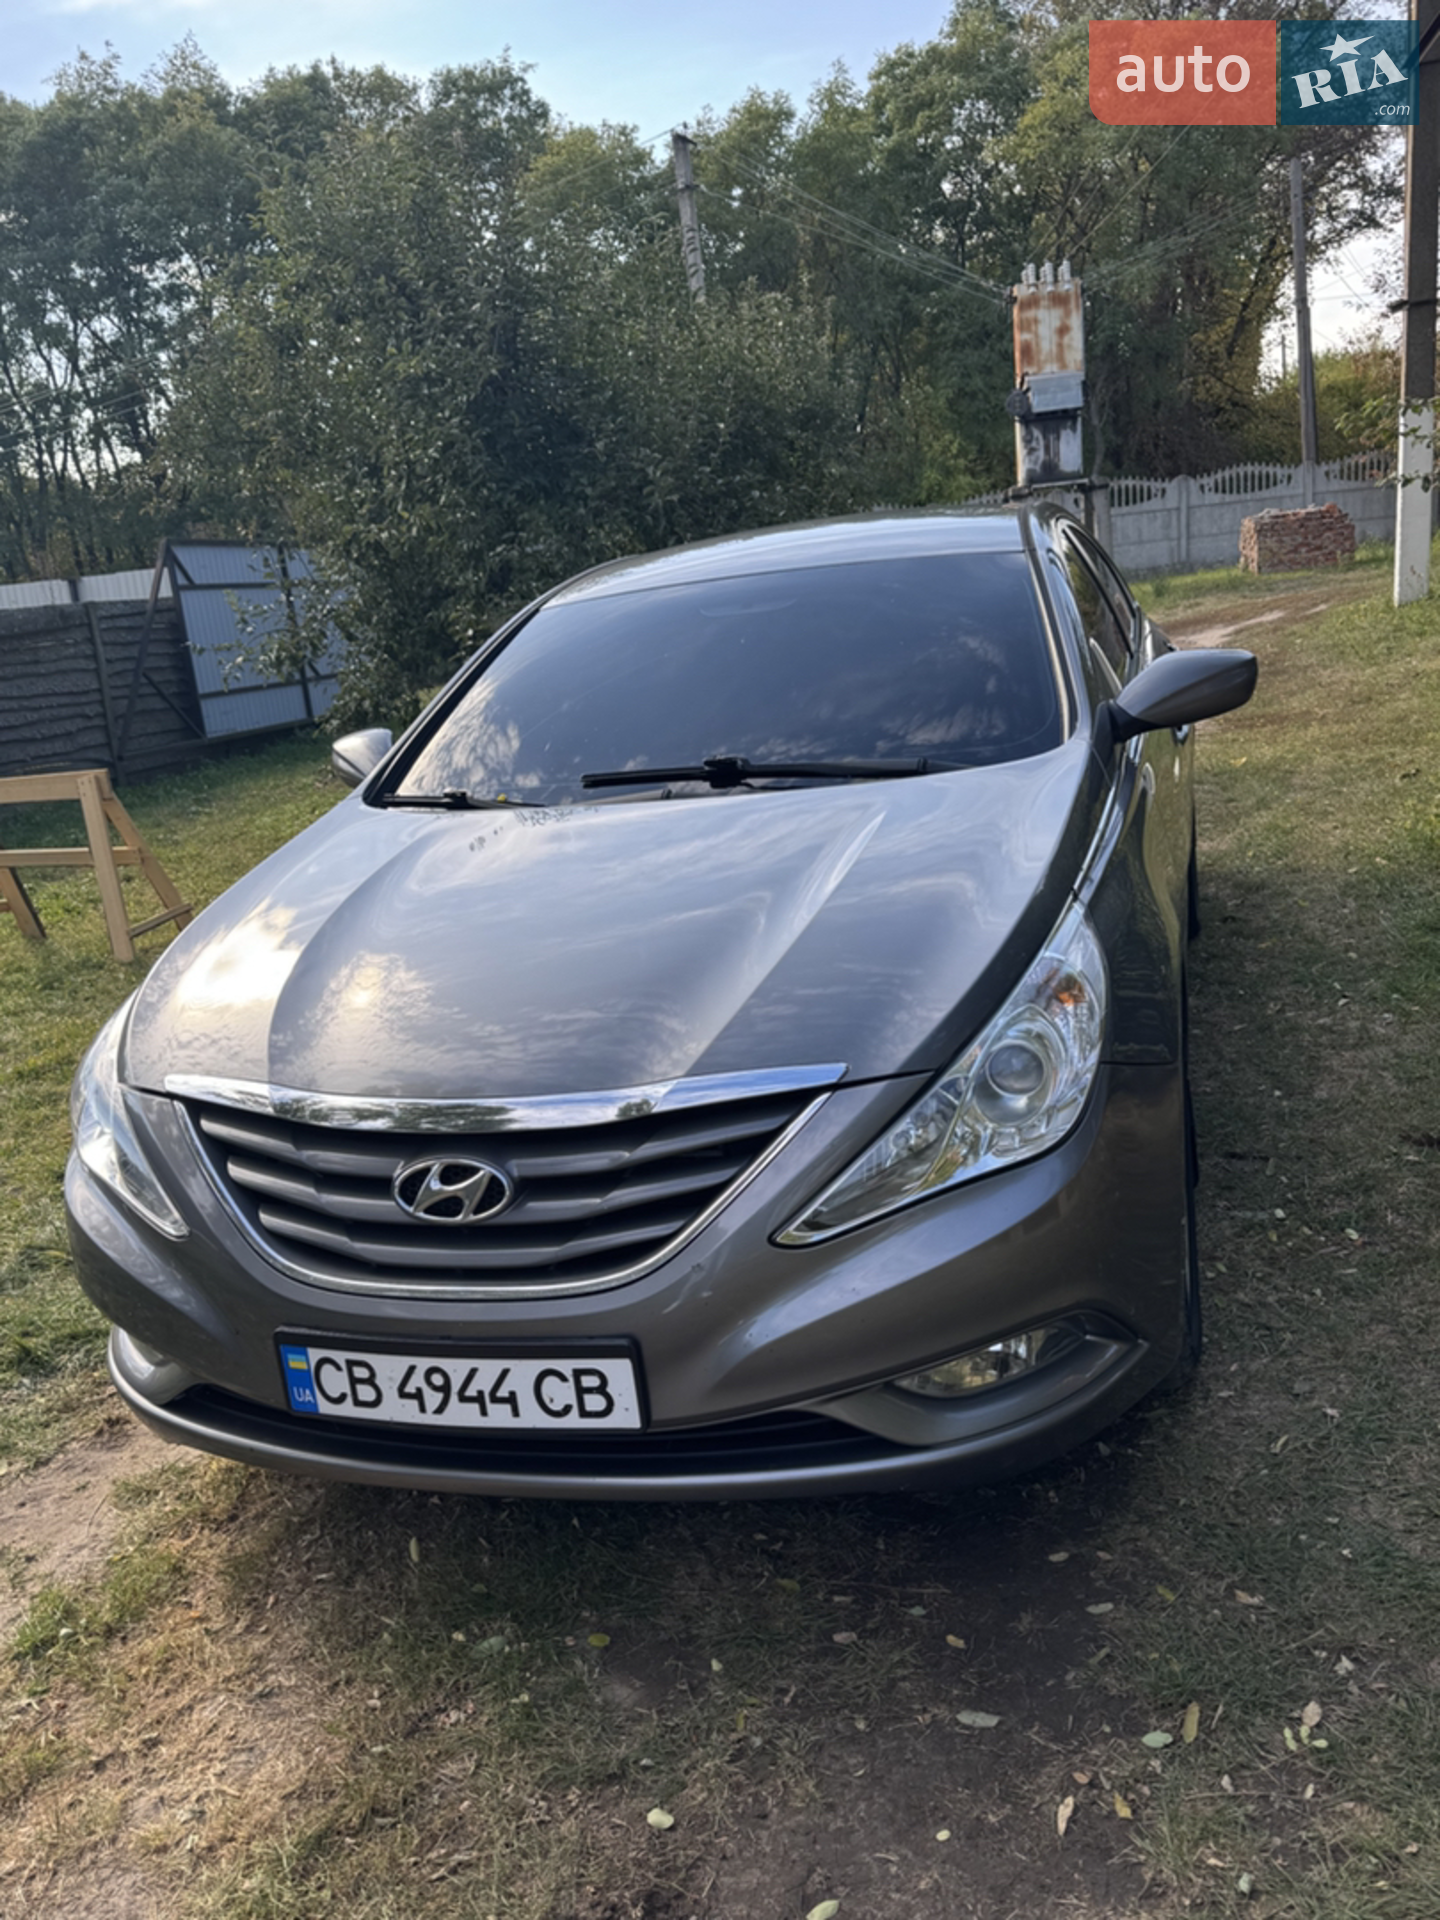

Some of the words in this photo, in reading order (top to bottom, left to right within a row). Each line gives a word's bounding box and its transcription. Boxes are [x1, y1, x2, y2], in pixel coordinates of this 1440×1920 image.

[293, 1387, 315, 1404] UA
[313, 1356, 383, 1409] CB
[397, 1364, 521, 1418] 4944
[533, 1367, 615, 1419] CB
